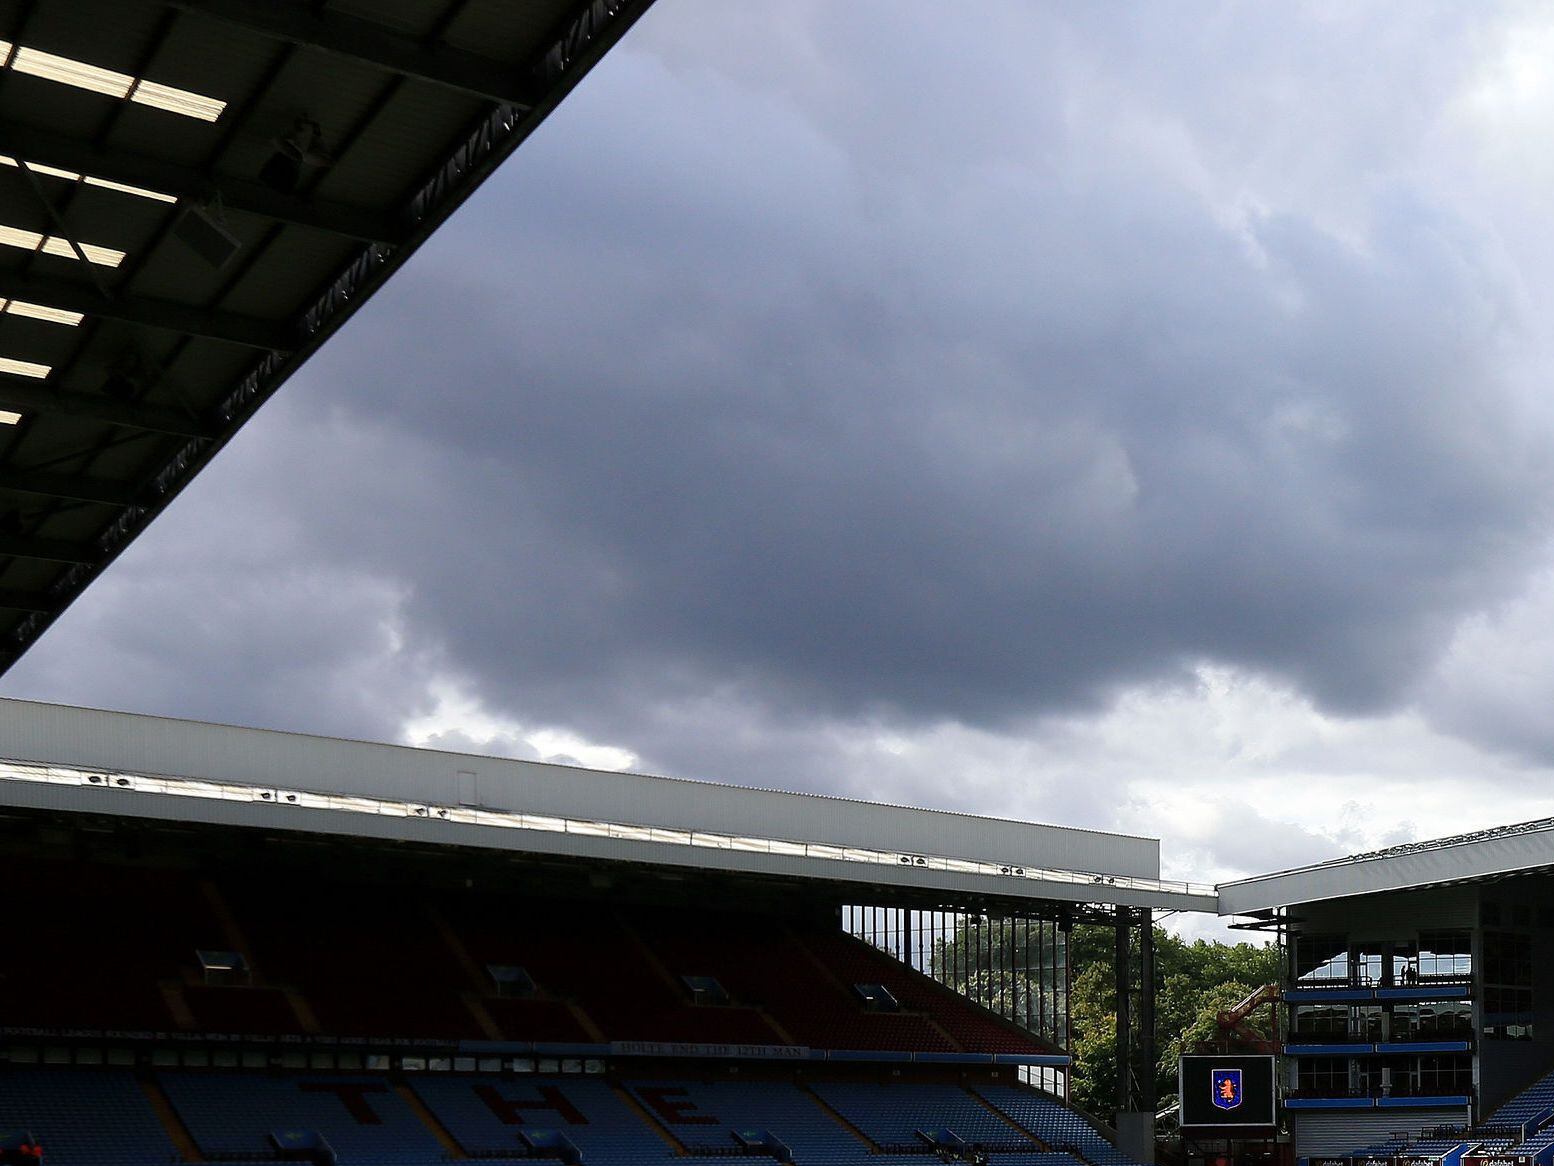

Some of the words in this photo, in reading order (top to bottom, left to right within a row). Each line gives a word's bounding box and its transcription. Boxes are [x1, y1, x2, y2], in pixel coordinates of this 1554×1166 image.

[670, 1043, 699, 1054] END
[702, 1044, 730, 1055] THE
[768, 1046, 802, 1057] MAN
[297, 1082, 719, 1125] THE
